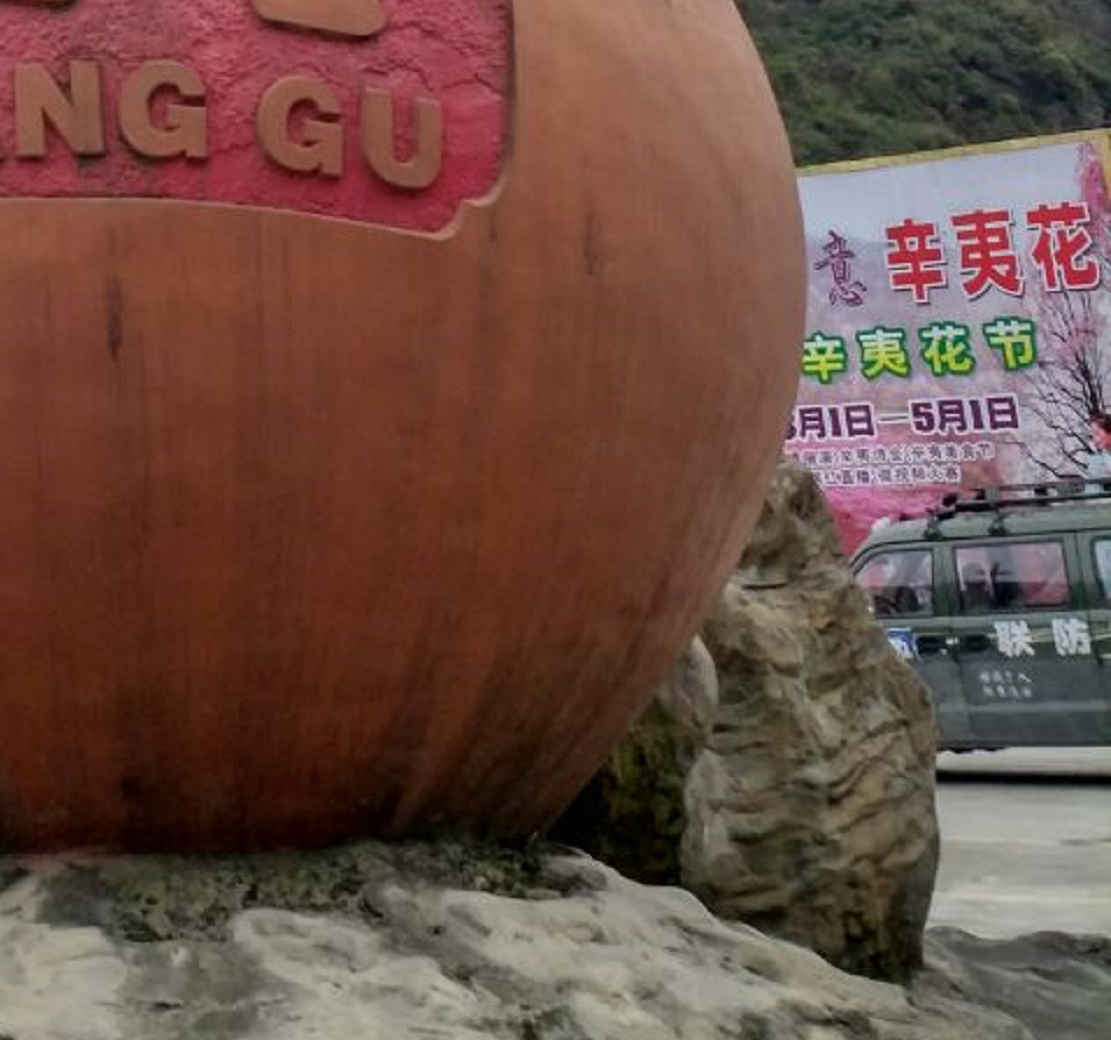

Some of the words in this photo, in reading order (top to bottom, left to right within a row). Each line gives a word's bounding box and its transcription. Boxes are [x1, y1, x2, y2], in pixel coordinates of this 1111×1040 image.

[255, 74, 443, 193] GU
[885, 202, 1100, 303] 辛夷花
[802, 317, 1038, 384] 辛夷花节
